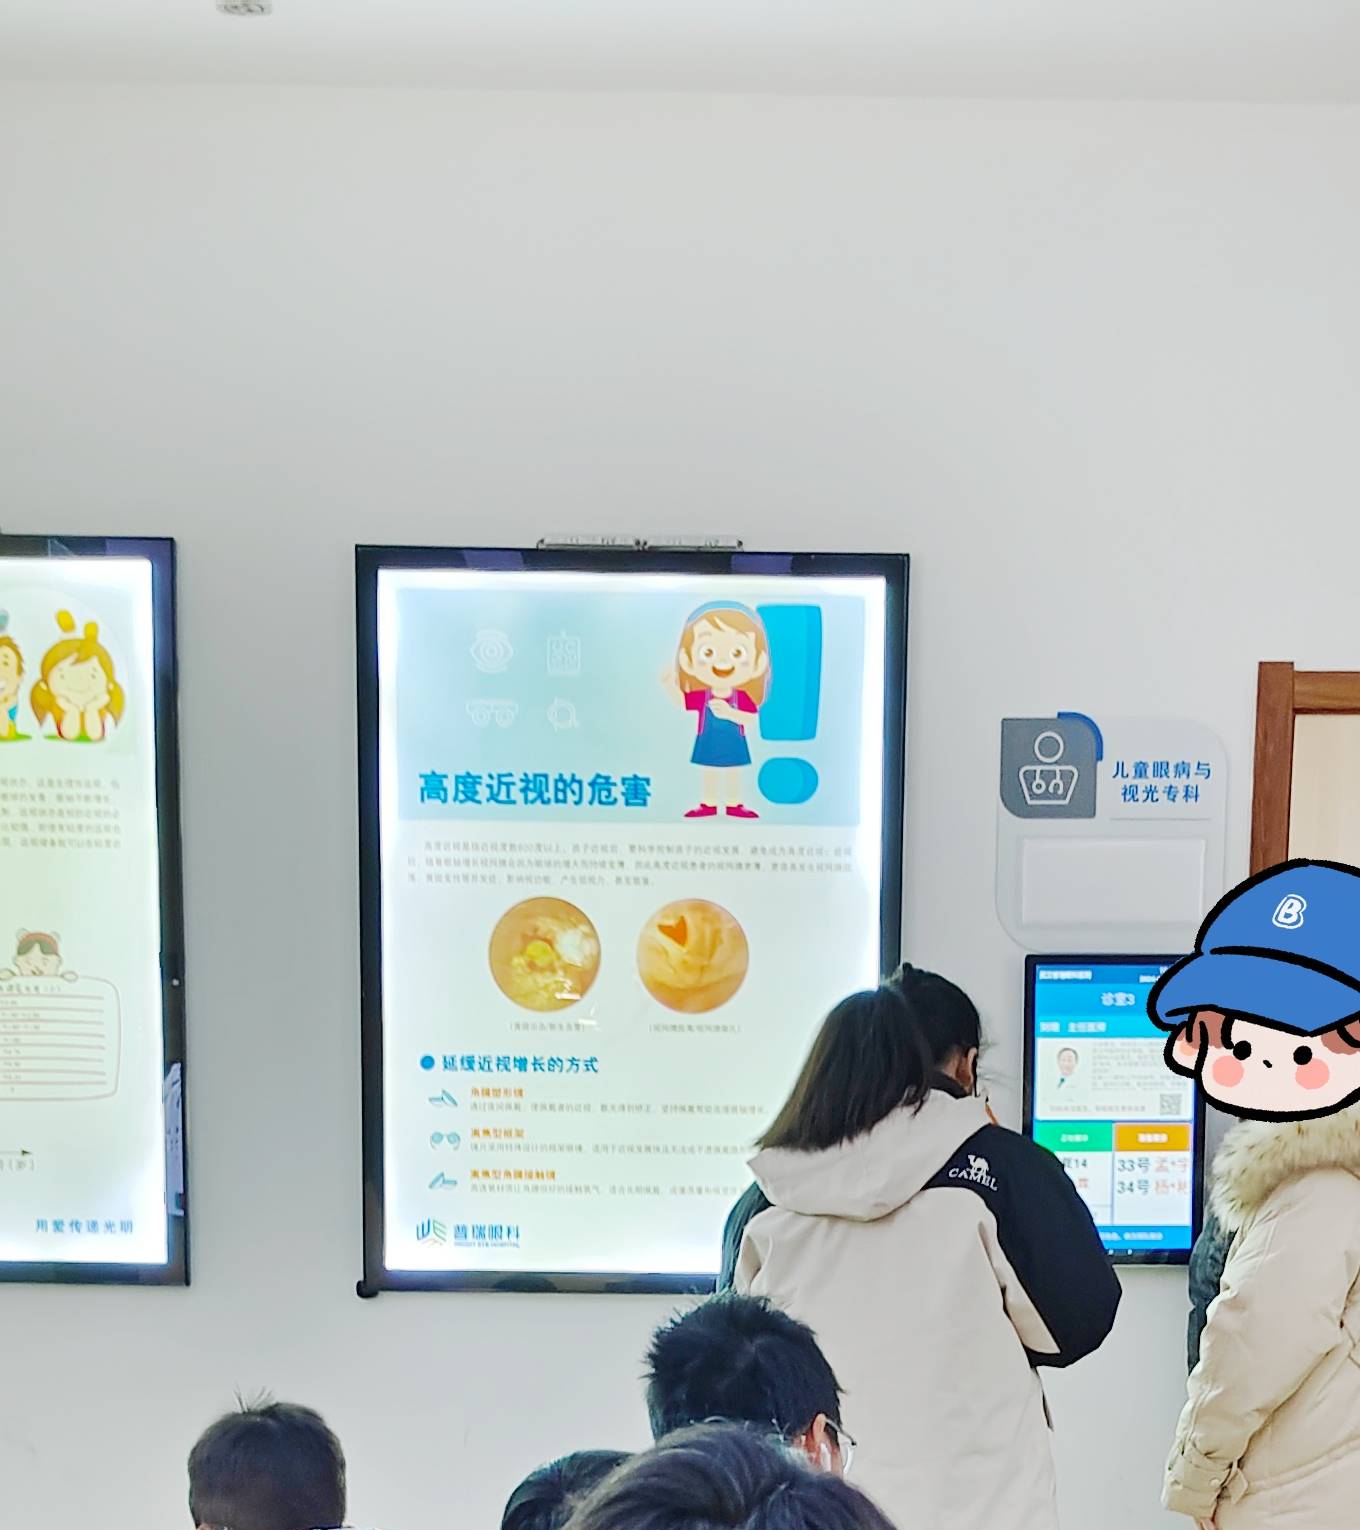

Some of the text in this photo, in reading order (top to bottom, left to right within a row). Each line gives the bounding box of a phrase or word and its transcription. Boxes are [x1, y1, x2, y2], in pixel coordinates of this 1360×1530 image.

[1112, 760, 1212, 780] 儿童眼病与
[418, 770, 653, 808] 高度近视的危害
[1121, 784, 1201, 804] 视光专科
[441, 1055, 599, 1074] 延缓近视增长的方式
[948, 1167, 998, 1191] CAMEL
[35, 1219, 134, 1234] 用爱传递光明
